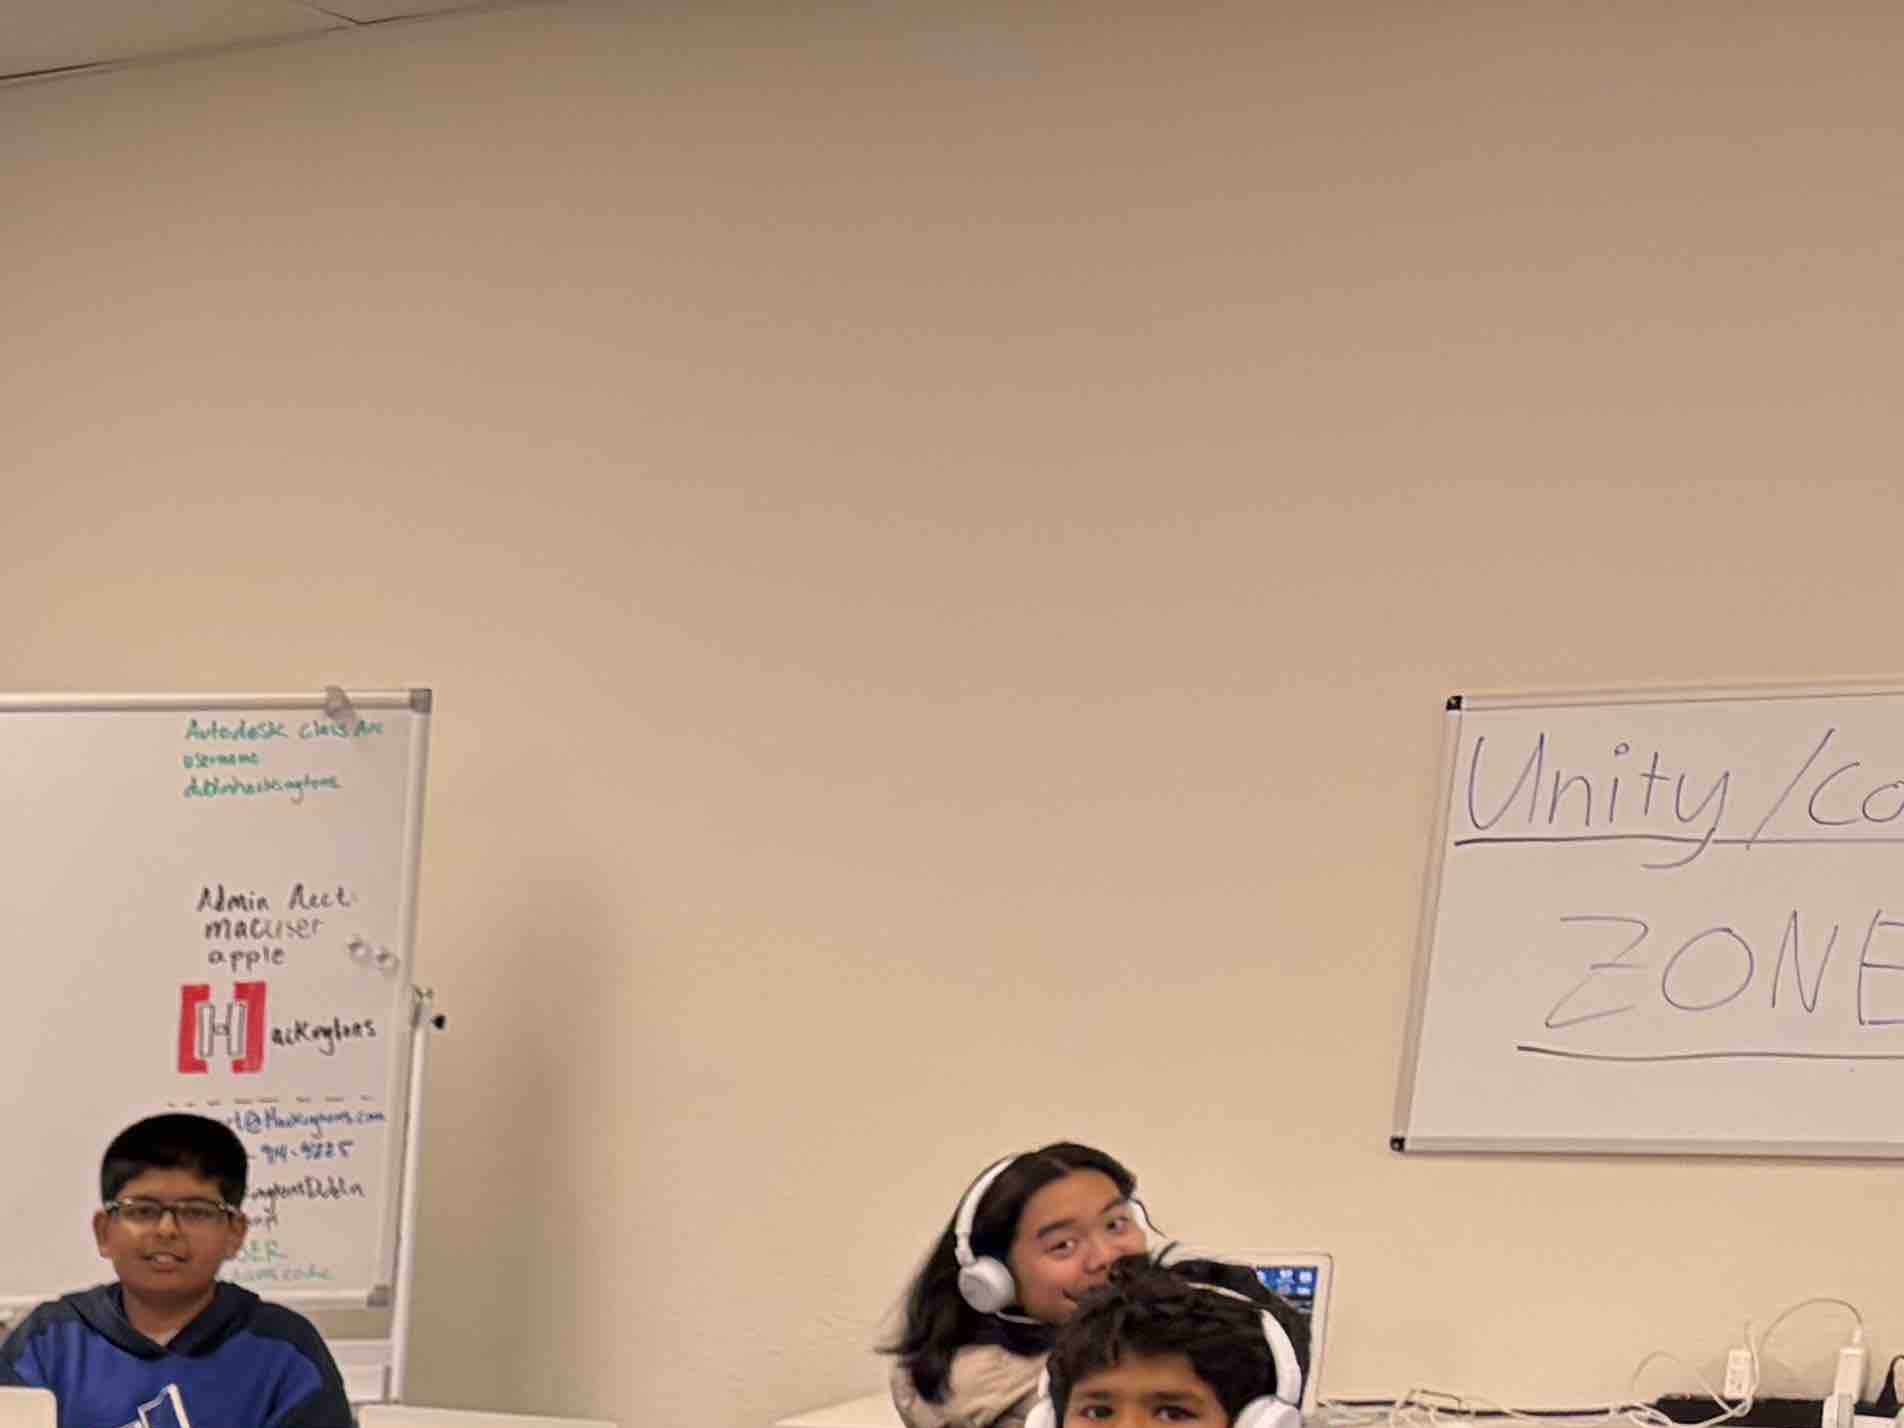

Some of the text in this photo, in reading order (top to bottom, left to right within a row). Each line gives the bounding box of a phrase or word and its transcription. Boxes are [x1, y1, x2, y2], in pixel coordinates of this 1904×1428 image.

[196, 883, 270, 912] Admin
[205, 917, 324, 940] macuser
[208, 946, 286, 972] apple
[1545, 909, 1904, 1030] ZONE
